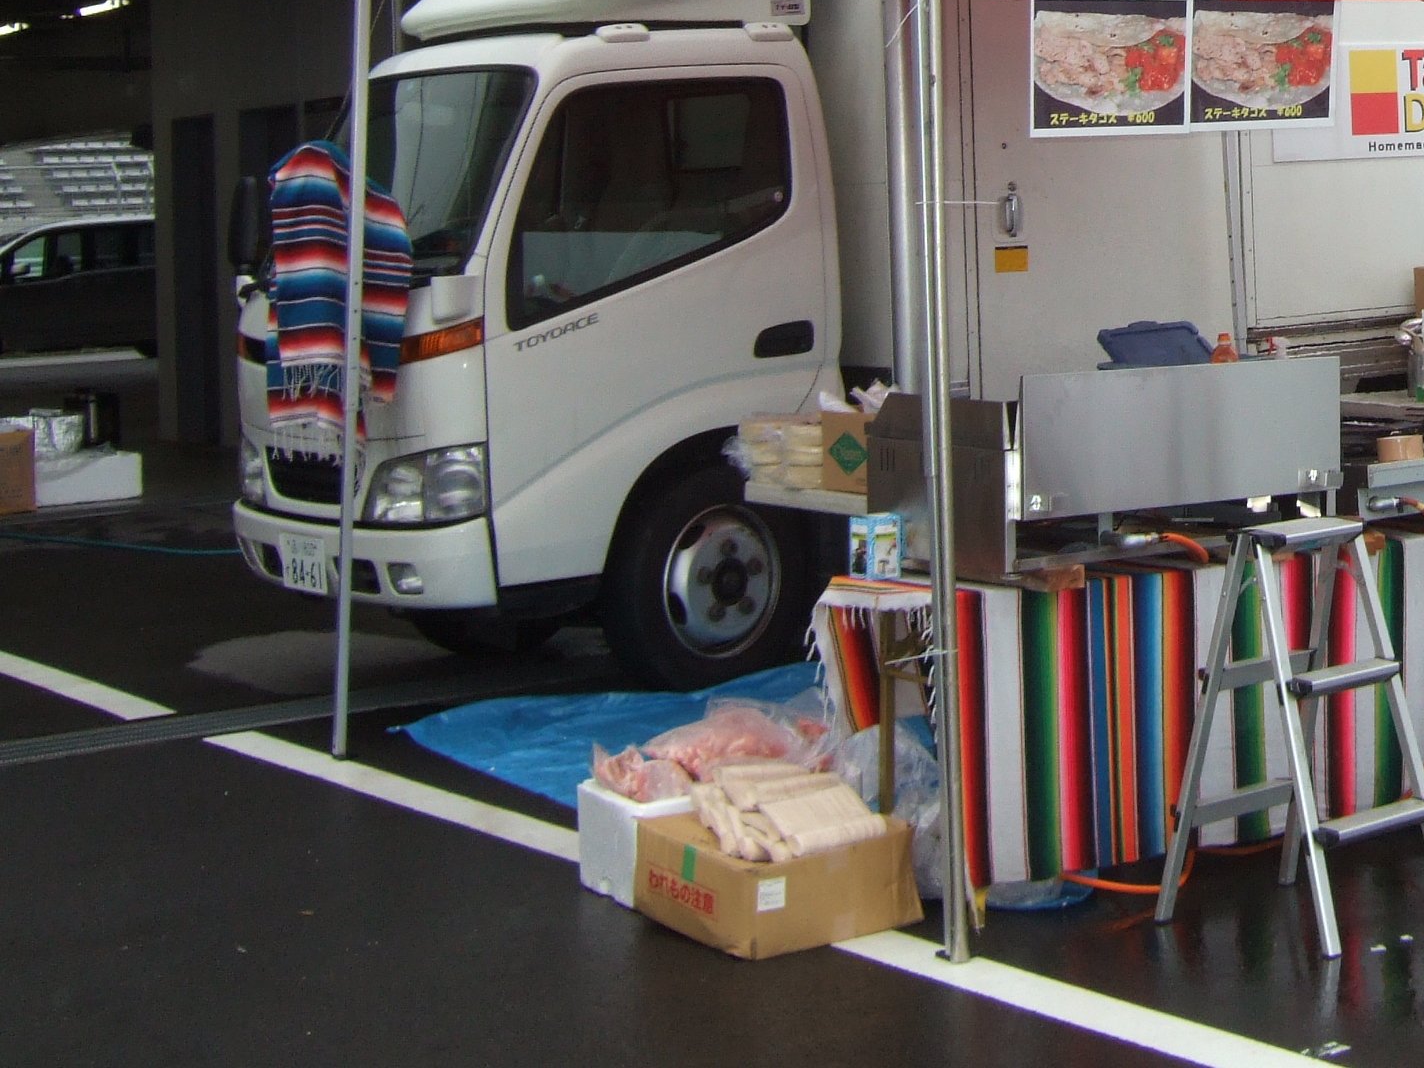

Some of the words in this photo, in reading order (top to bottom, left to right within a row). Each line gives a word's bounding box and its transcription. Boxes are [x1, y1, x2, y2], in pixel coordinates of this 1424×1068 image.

[1050, 112, 1117, 126] ステーキタコス
[1204, 107, 1267, 120] ステーキタコス
[513, 313, 600, 352] TOYOACE
[648, 868, 714, 915] われもの注意
